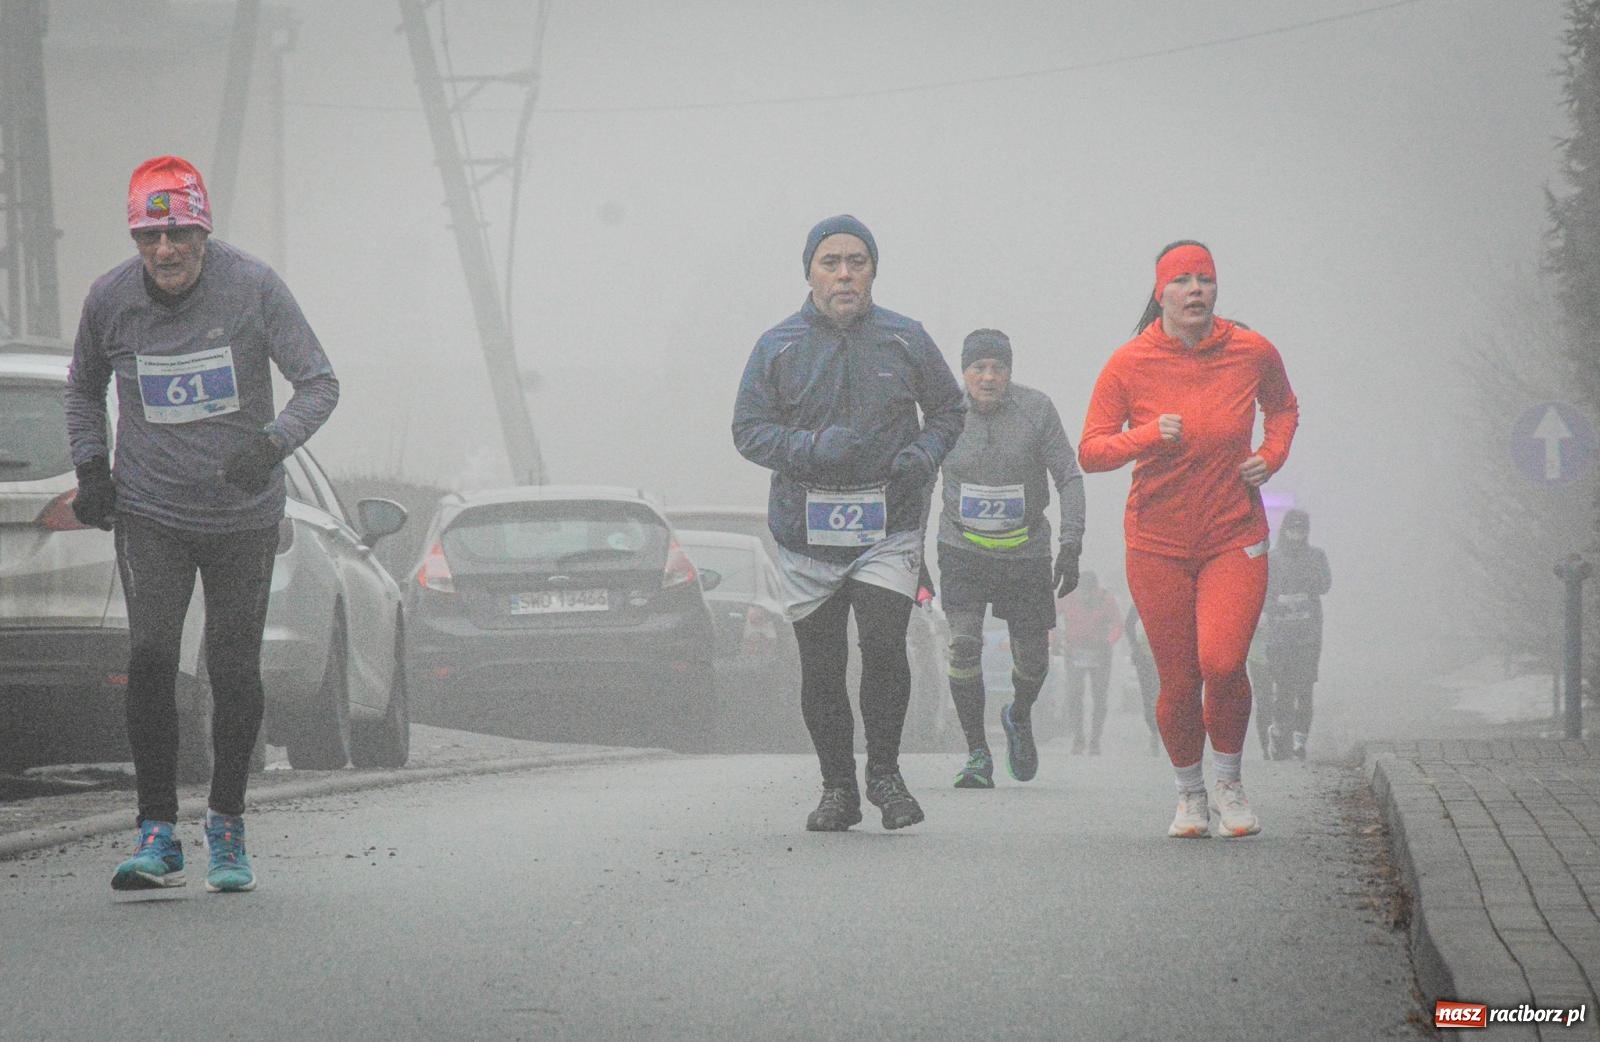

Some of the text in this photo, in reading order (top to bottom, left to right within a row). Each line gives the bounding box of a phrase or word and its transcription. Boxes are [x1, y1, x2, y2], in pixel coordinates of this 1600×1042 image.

[166, 373, 210, 405] 61
[828, 504, 864, 530] 62
[977, 499, 1006, 518] 22
